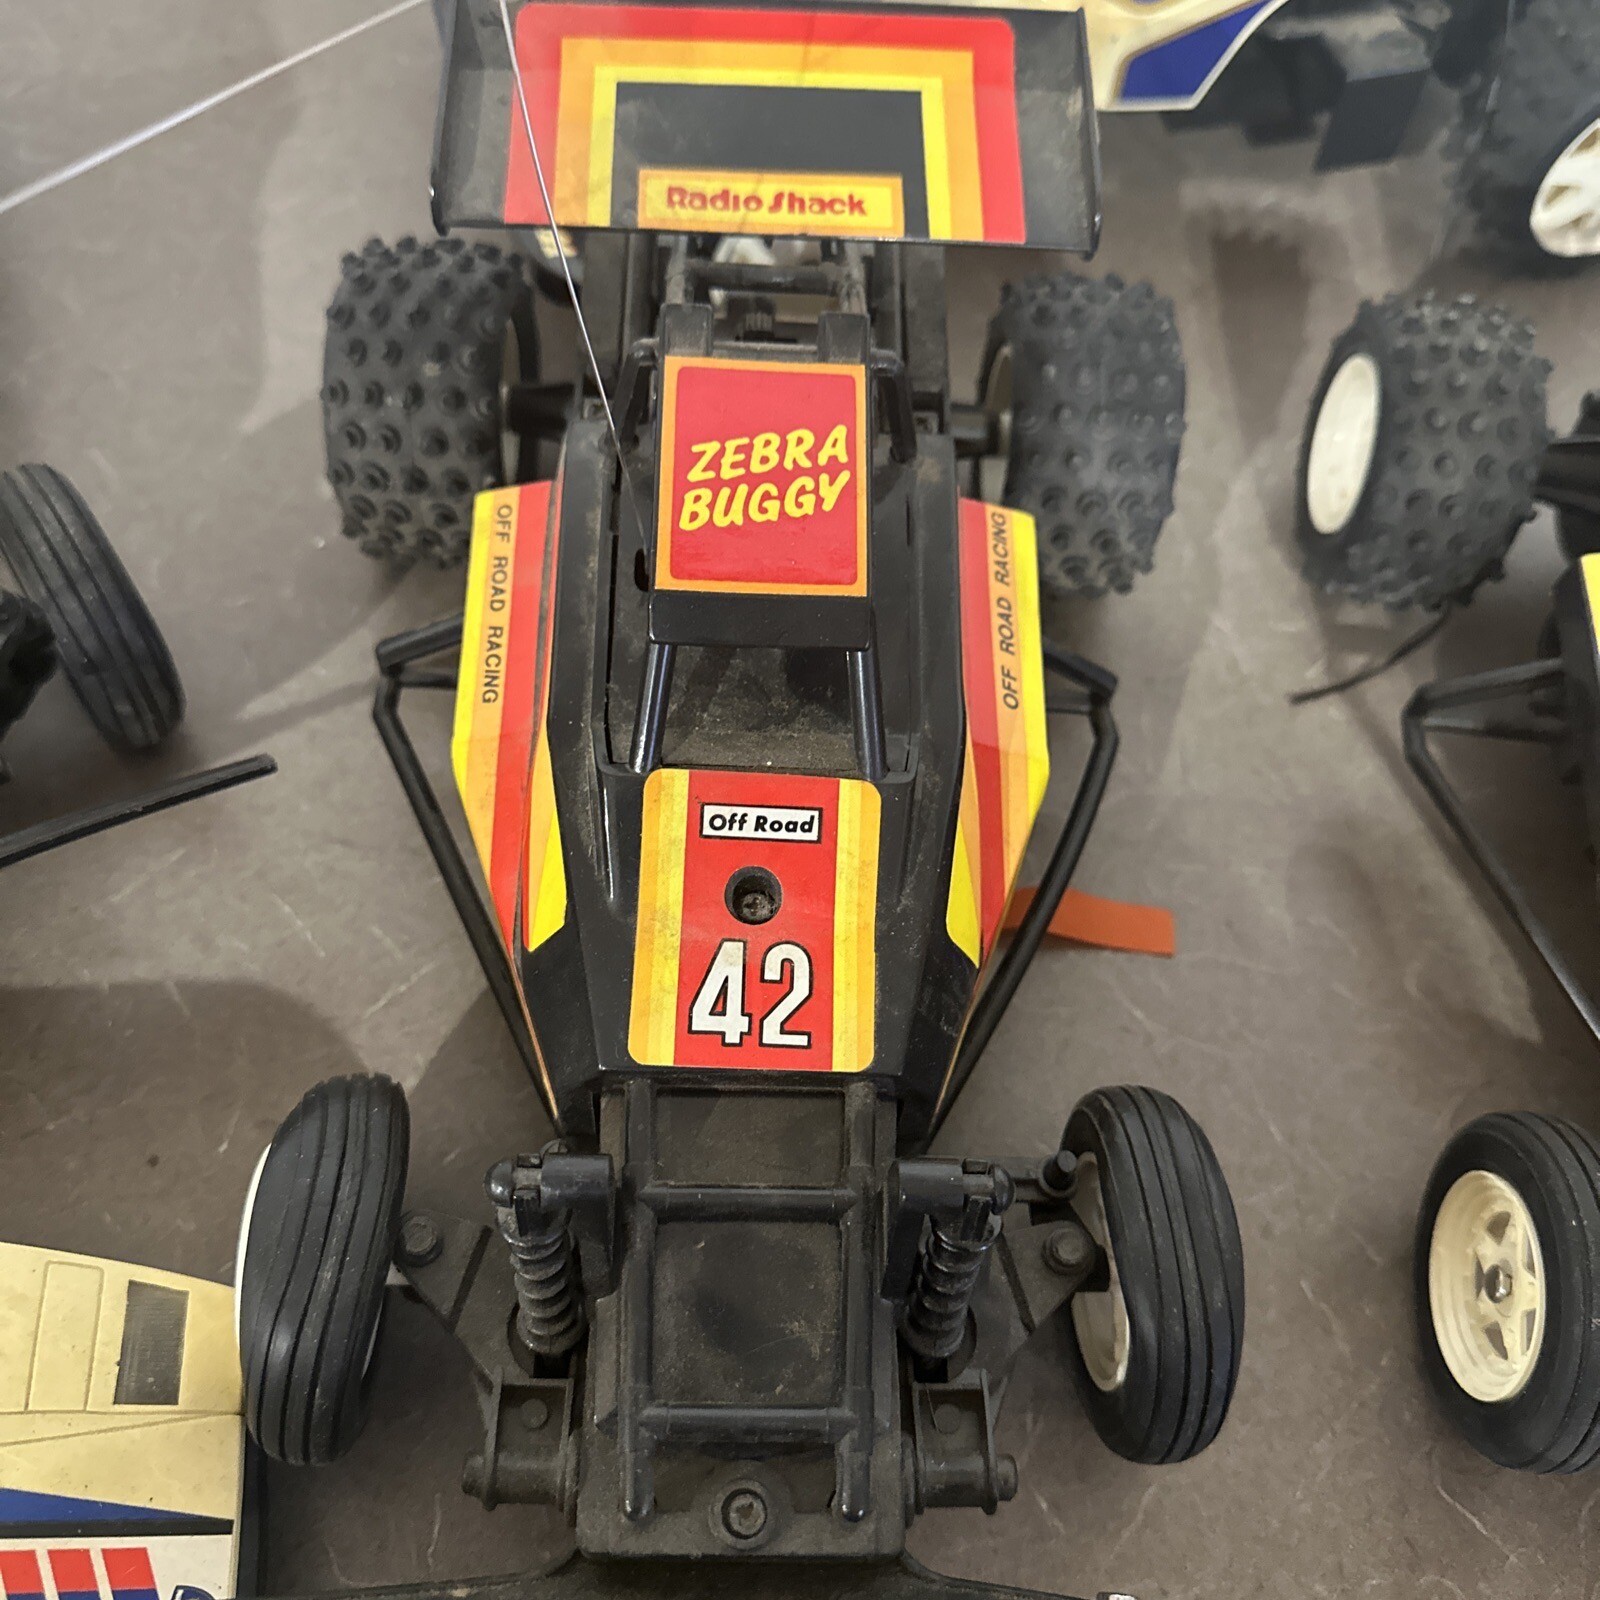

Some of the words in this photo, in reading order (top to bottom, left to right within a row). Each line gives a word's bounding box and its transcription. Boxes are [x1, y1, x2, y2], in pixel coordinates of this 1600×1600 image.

[666, 185, 763, 212] Radio
[768, 191, 867, 216] Shack
[687, 424, 848, 482] ZEBRA
[496, 504, 513, 543] OFF
[679, 470, 851, 531] BUGGY
[991, 511, 1011, 587] RACING
[489, 556, 509, 612] ROAD
[997, 597, 1016, 655] ROAD
[482, 625, 504, 704] RACING
[1001, 665, 1019, 710] OFF
[708, 813, 749, 832] Off
[754, 815, 815, 833] Road
[687, 938, 814, 1049] 42
